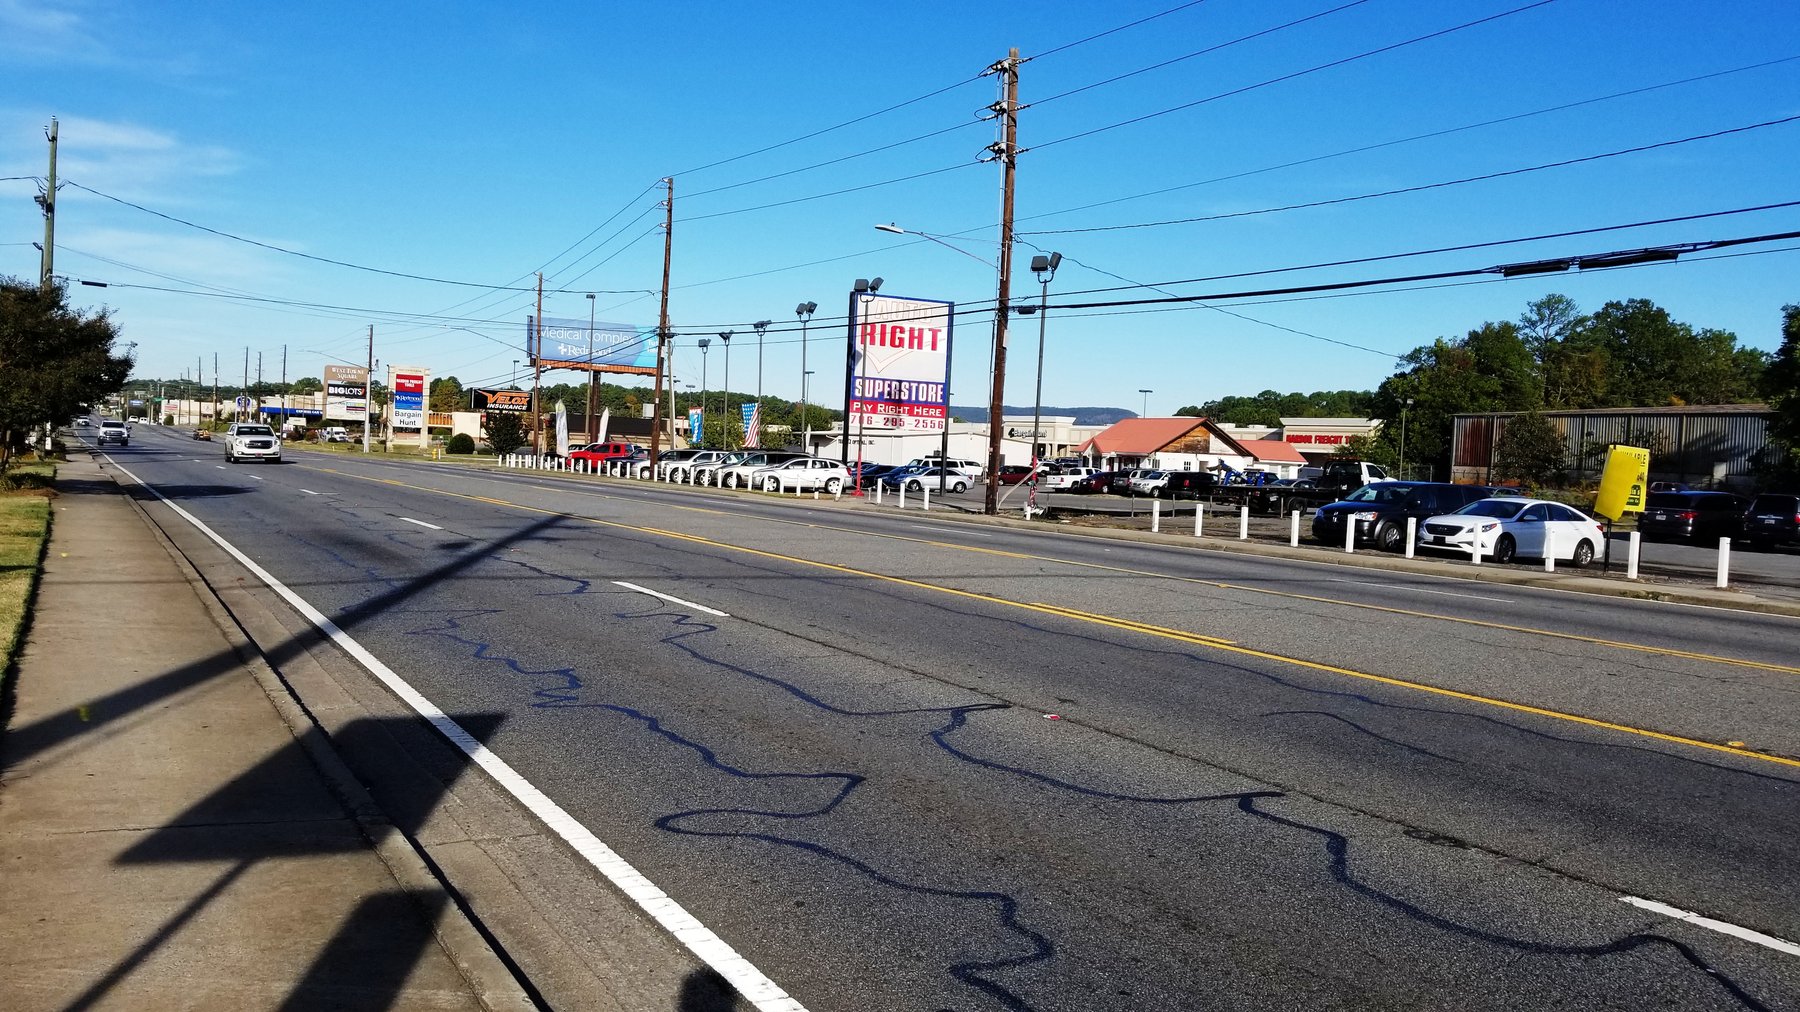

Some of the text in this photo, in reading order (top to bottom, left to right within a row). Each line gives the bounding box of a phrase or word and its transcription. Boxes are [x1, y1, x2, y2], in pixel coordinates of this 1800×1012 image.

[874, 300, 933, 324] AUTO
[541, 326, 582, 340] Medical
[586, 329, 636, 345] Complex
[860, 322, 942, 351] RIGHT
[481, 391, 530, 405] VELOX
[855, 379, 943, 402] SUPERSTORE
[853, 402, 942, 416] PAY RIGHT HERE
